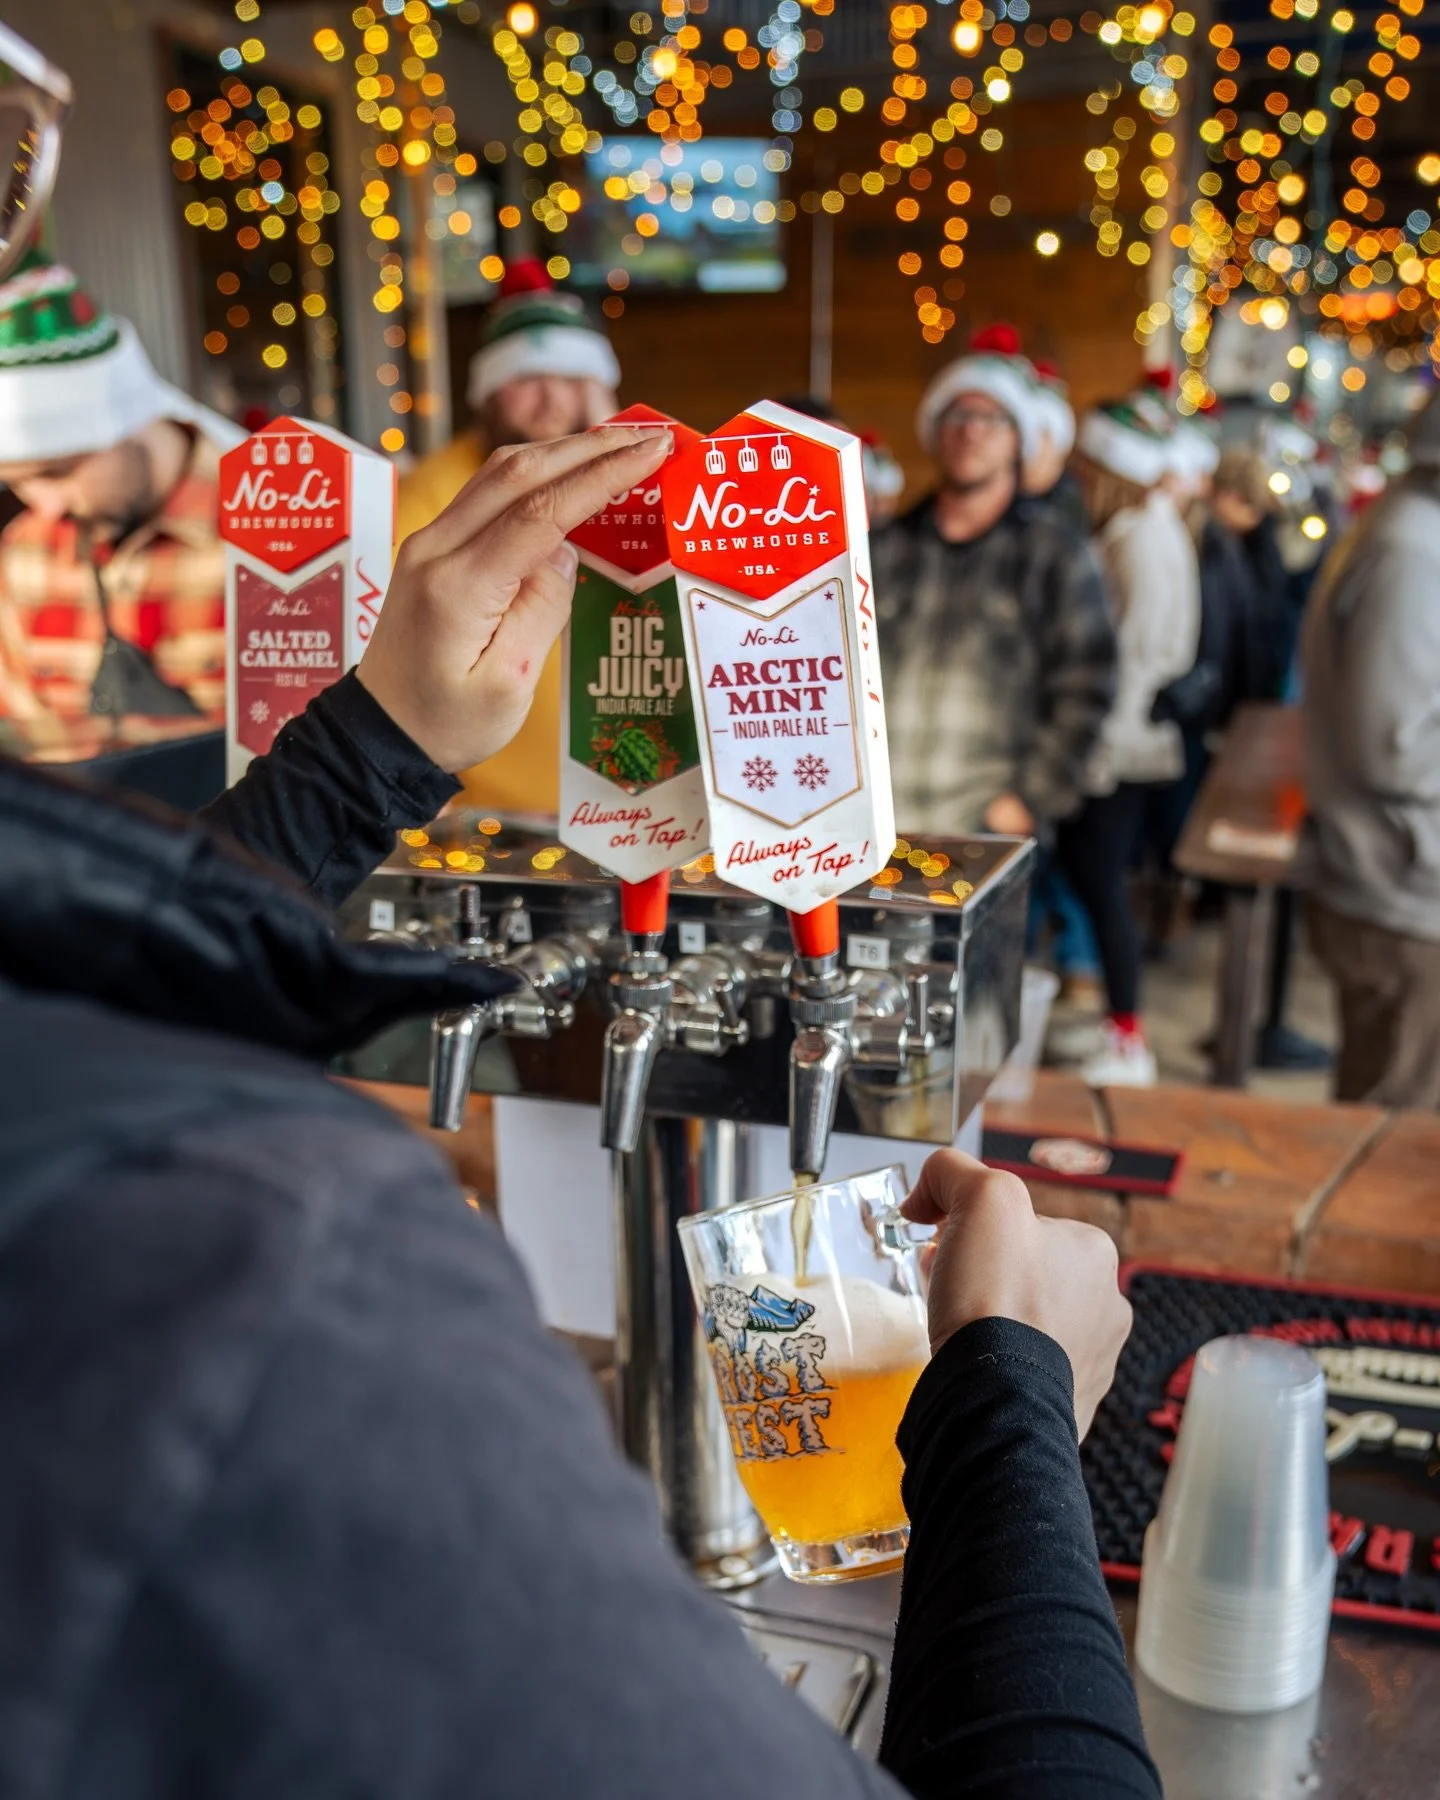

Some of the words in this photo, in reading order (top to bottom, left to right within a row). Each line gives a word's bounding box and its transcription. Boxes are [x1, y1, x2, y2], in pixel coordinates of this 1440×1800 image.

[222, 468, 341, 511] No-Li
[672, 476, 836, 532] No-Li
[229, 516, 335, 530] BREWHOUSE
[685, 532, 829, 553] BREWHOUSE
[266, 598, 312, 616] No-Li
[248, 630, 331, 650] SALTED
[610, 616, 665, 657] BIG
[739, 626, 800, 647] No-Li
[240, 650, 339, 668] CARAMEL
[588, 656, 684, 698] JUICY
[707, 655, 844, 688] ARCTIC
[596, 698, 627, 715] INDIA
[627, 698, 653, 716] PALE
[655, 699, 674, 716] ALE
[726, 686, 827, 715] MINT
[733, 720, 770, 740] INDIA
[773, 718, 803, 737] PALE
[806, 716, 829, 736] ALE
[569, 801, 652, 830] Always
[609, 833, 640, 848] on
[726, 837, 812, 868] Always
[773, 865, 804, 882] on
